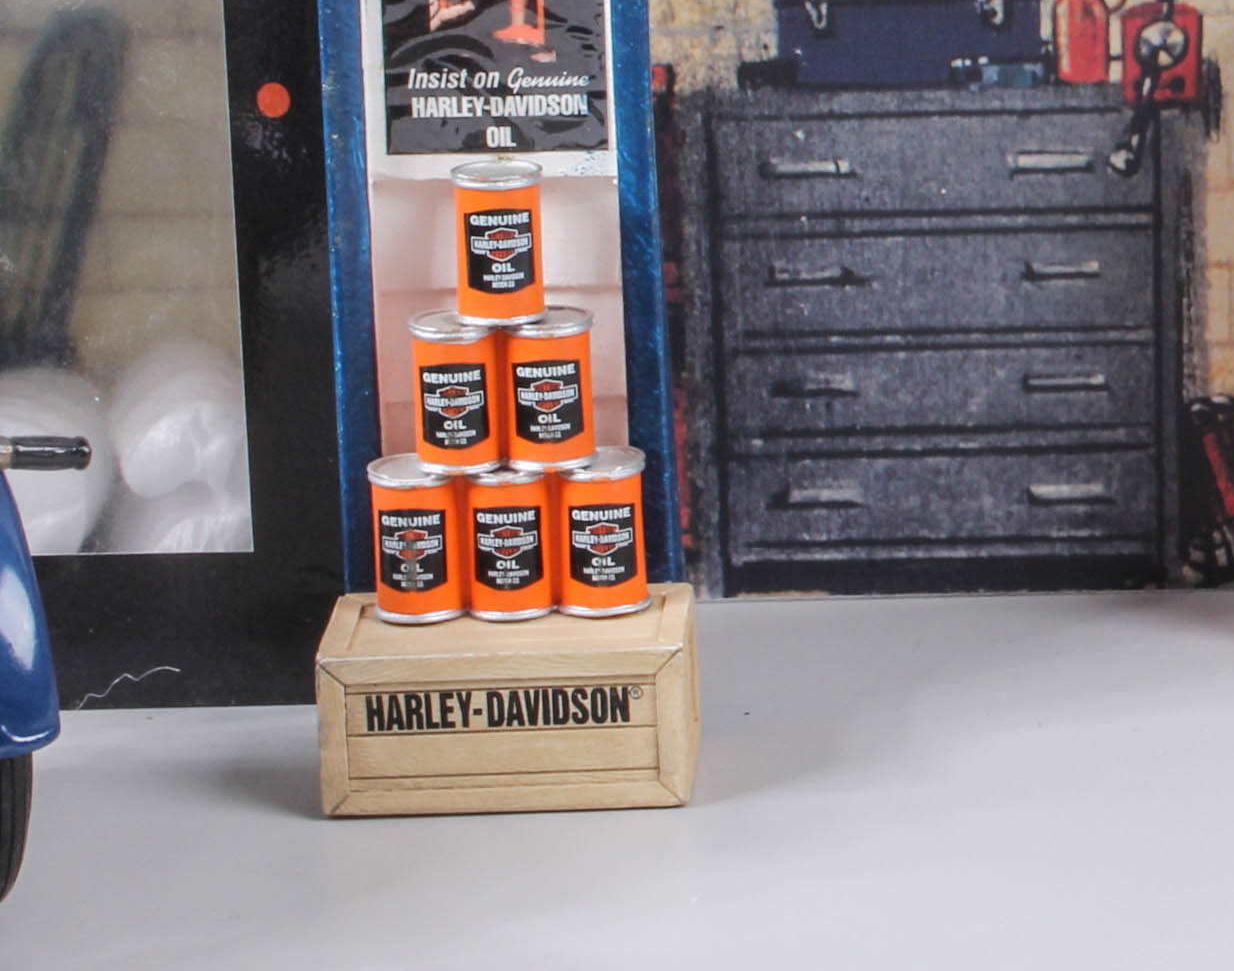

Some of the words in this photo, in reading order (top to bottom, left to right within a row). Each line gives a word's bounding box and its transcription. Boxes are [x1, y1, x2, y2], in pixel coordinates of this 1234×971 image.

[408, 68, 468, 89] Insist
[473, 71, 501, 89] on
[507, 67, 590, 94] Genuine
[411, 94, 589, 119] HARLEY-DAVIDSON
[486, 126, 517, 148] OIL
[469, 211, 530, 226] GENUINE
[491, 262, 516, 273] OIL
[422, 369, 482, 384] GENUINE
[516, 363, 576, 378] GENUINE
[443, 419, 467, 430] OIL
[538, 413, 562, 424] OIL
[476, 510, 536, 524] GENUINE
[572, 506, 631, 521] GENUINE
[381, 514, 441, 528] GENUINE
[496, 559, 520, 570] OIL
[591, 556, 616, 567] OIL
